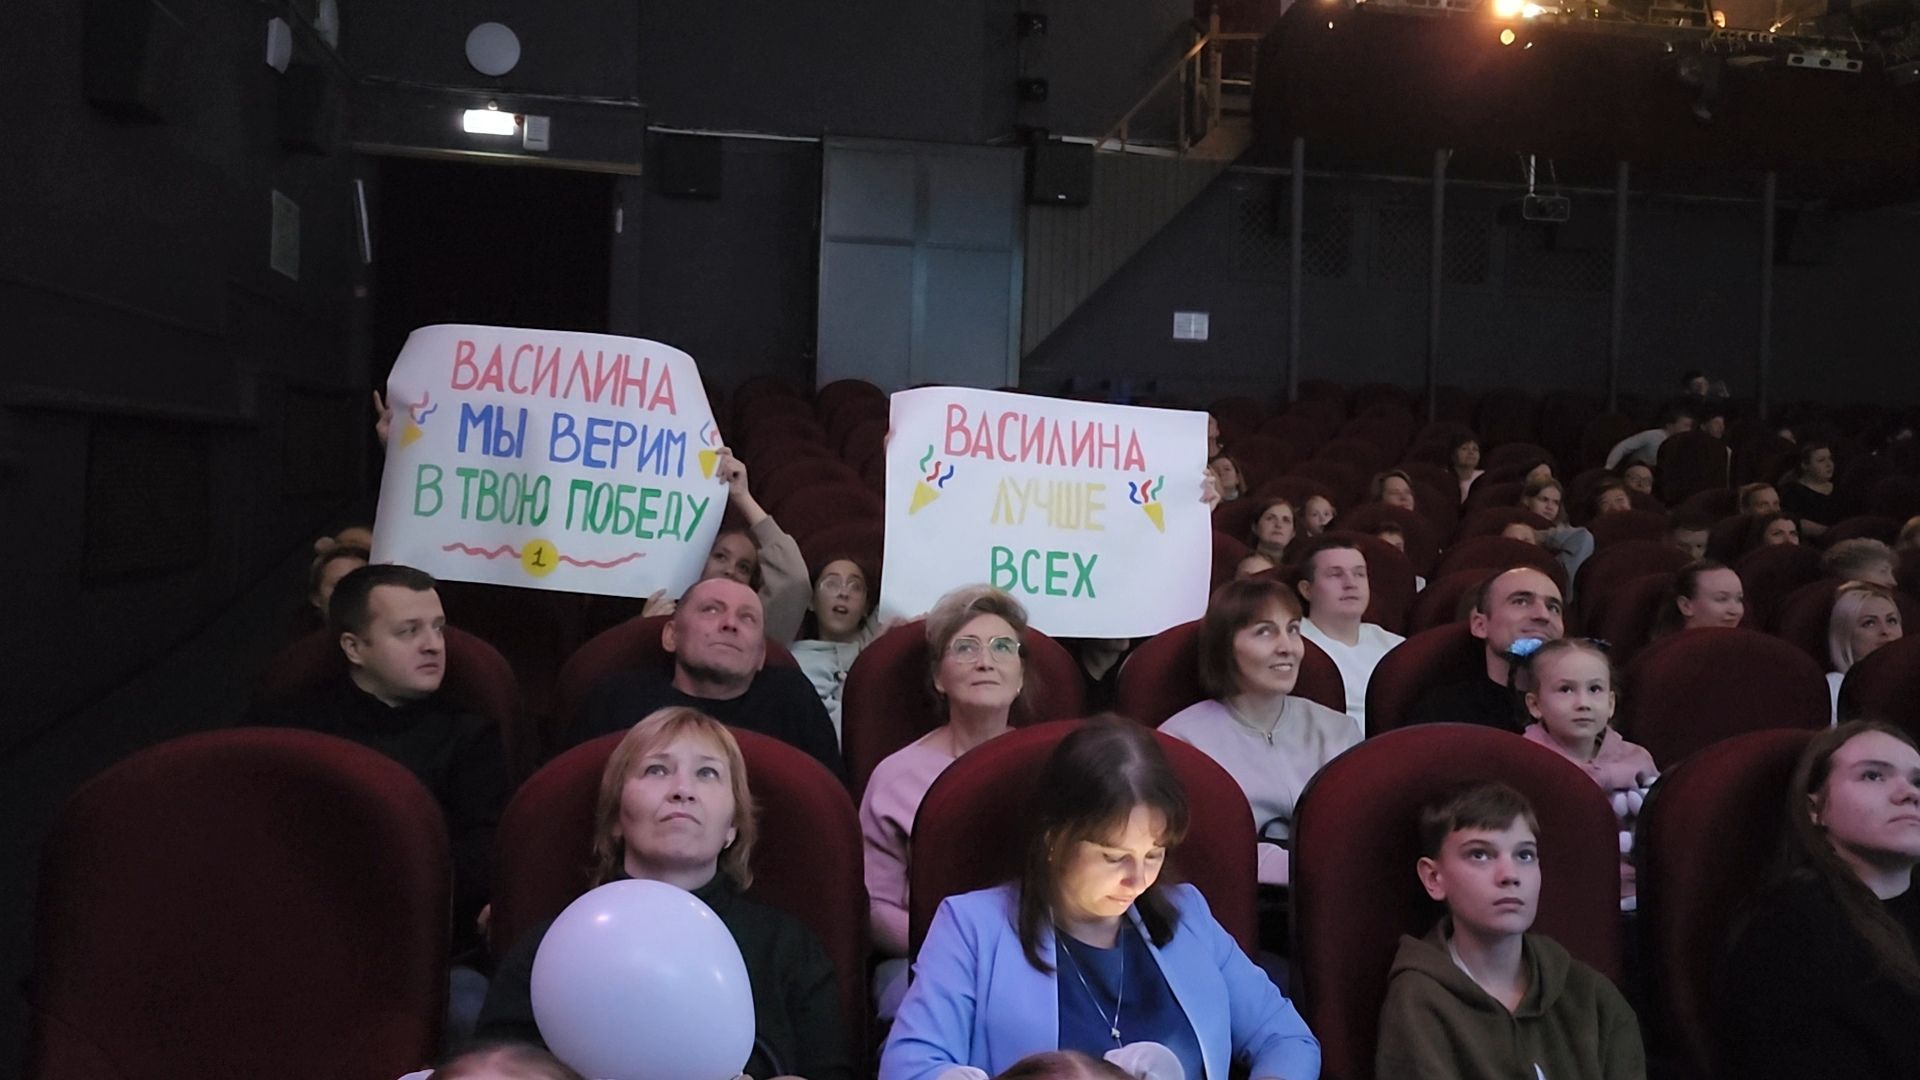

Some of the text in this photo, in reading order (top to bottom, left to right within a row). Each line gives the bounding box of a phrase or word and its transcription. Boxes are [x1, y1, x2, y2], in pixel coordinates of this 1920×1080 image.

[450, 340, 677, 416] ВАСИЛИНА
[457, 402, 687, 478] МЫ ВЕРИМ
[944, 403, 1146, 472] ВАСИЛИНА
[413, 464, 711, 542] В ТВОЮ ПОБЕДУ
[991, 475, 1106, 532] ЛУЧШЕ
[532, 547, 546, 567] 1
[990, 545, 1098, 598] ВСЕХ
